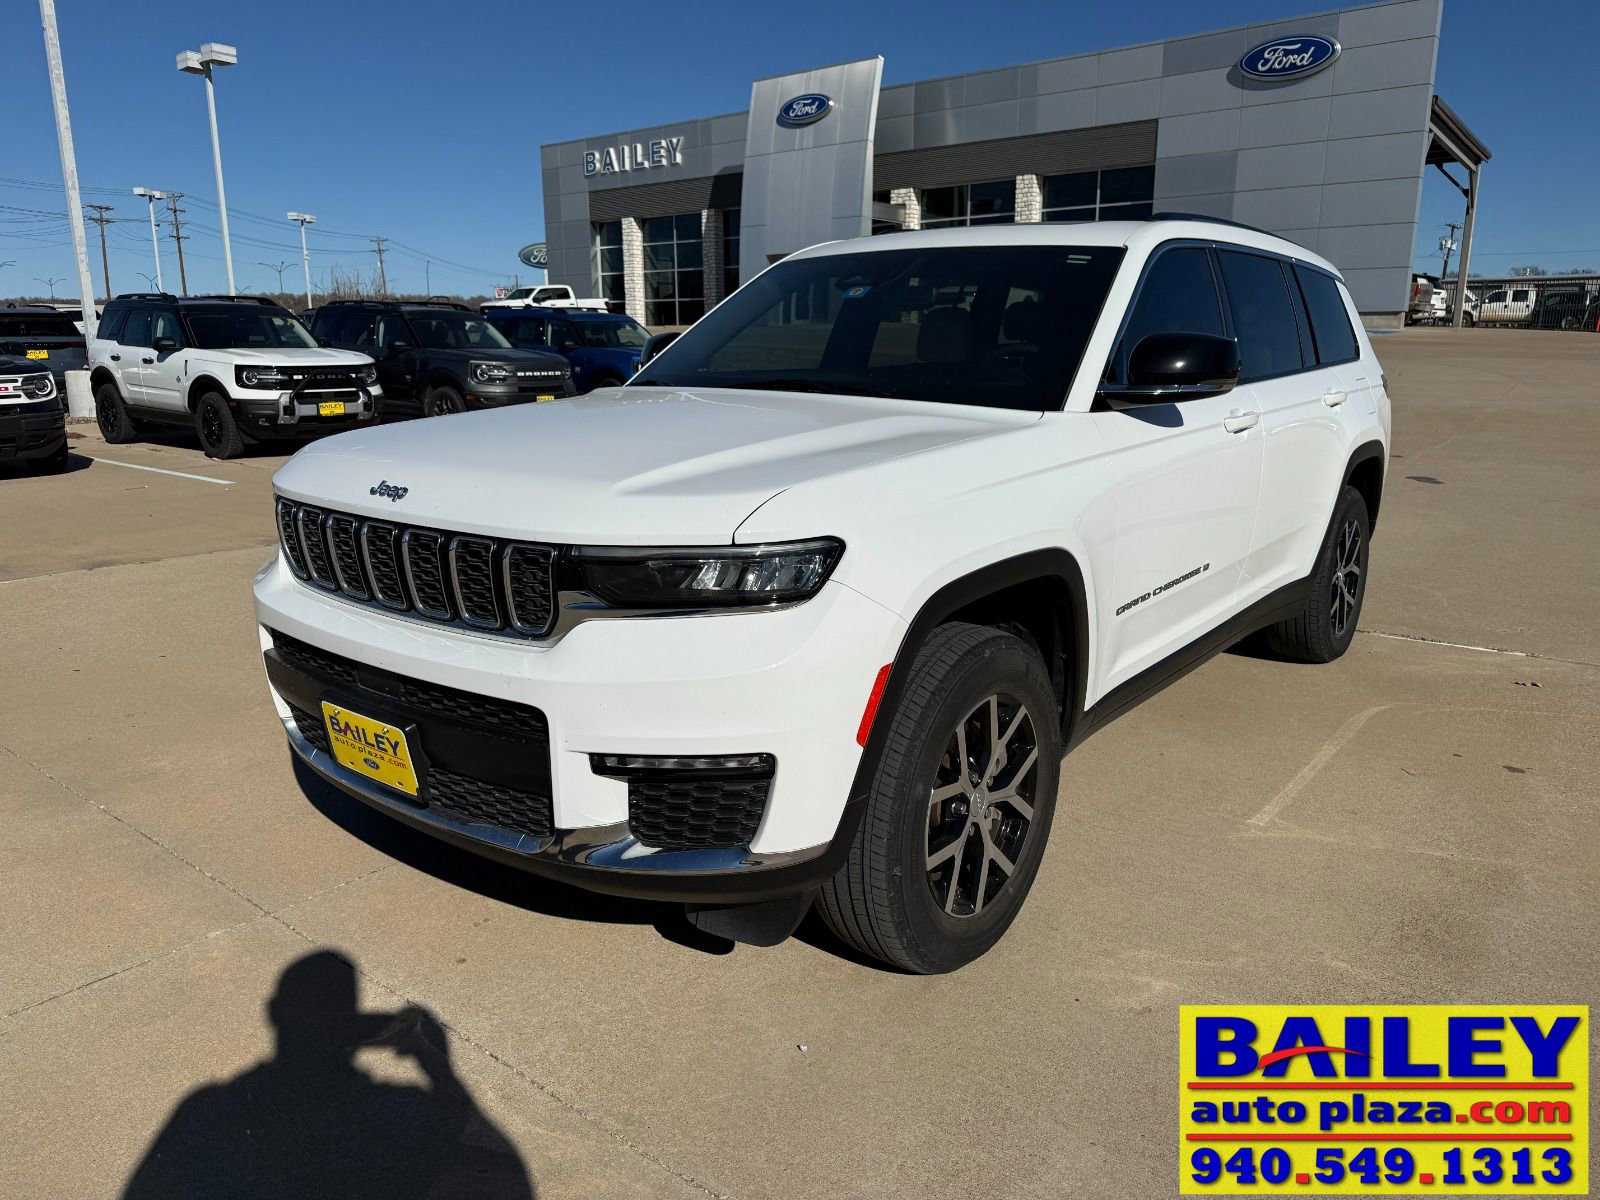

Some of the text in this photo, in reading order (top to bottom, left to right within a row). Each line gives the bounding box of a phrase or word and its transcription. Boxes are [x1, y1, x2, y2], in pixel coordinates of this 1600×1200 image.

[1257, 43, 1315, 72] Ford
[789, 99, 819, 117] Ford
[583, 136, 684, 176] BAILEY
[530, 248, 548, 263] Fo
[370, 480, 408, 502] Jeep
[1116, 592, 1151, 616] GRAND
[1153, 566, 1202, 596] CHEROKEE
[329, 714, 399, 757] BAILEY
[334, 735, 356, 749] auto
